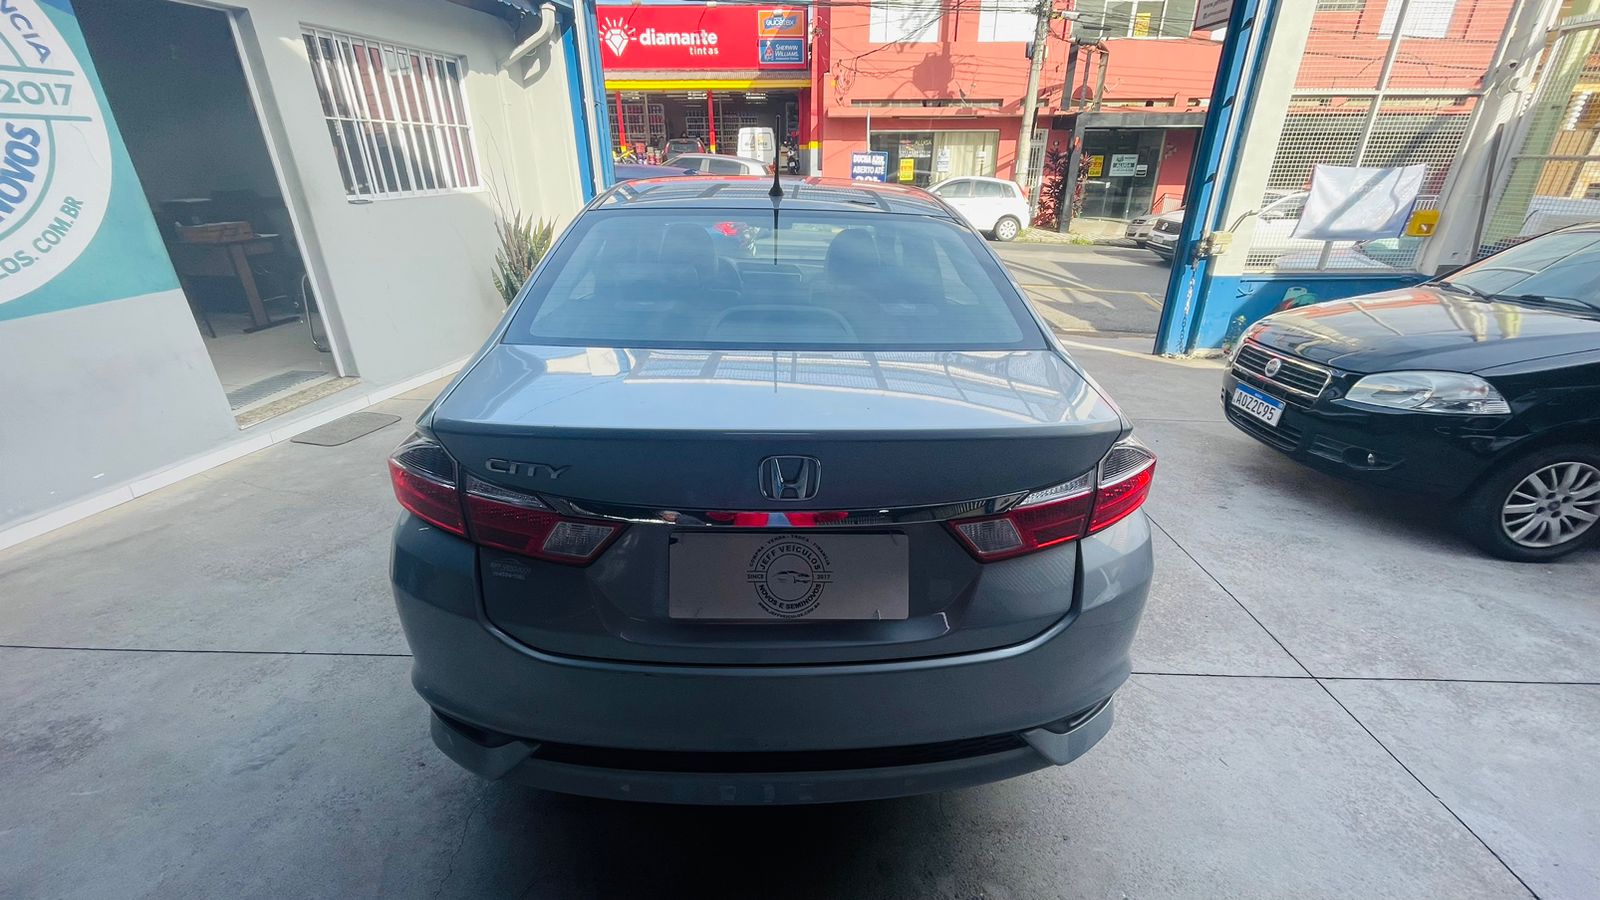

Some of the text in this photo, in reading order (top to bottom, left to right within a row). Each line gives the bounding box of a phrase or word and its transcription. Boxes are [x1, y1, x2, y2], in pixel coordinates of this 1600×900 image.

[640, 28, 718, 46] diamante
[689, 46, 719, 56] tintas
[0, 79, 73, 106] 2017
[485, 458, 572, 479] CITY
[760, 549, 776, 570] JEFF
[759, 584, 778, 606] NOVOS
[785, 583, 821, 609] SEMINOVOS
